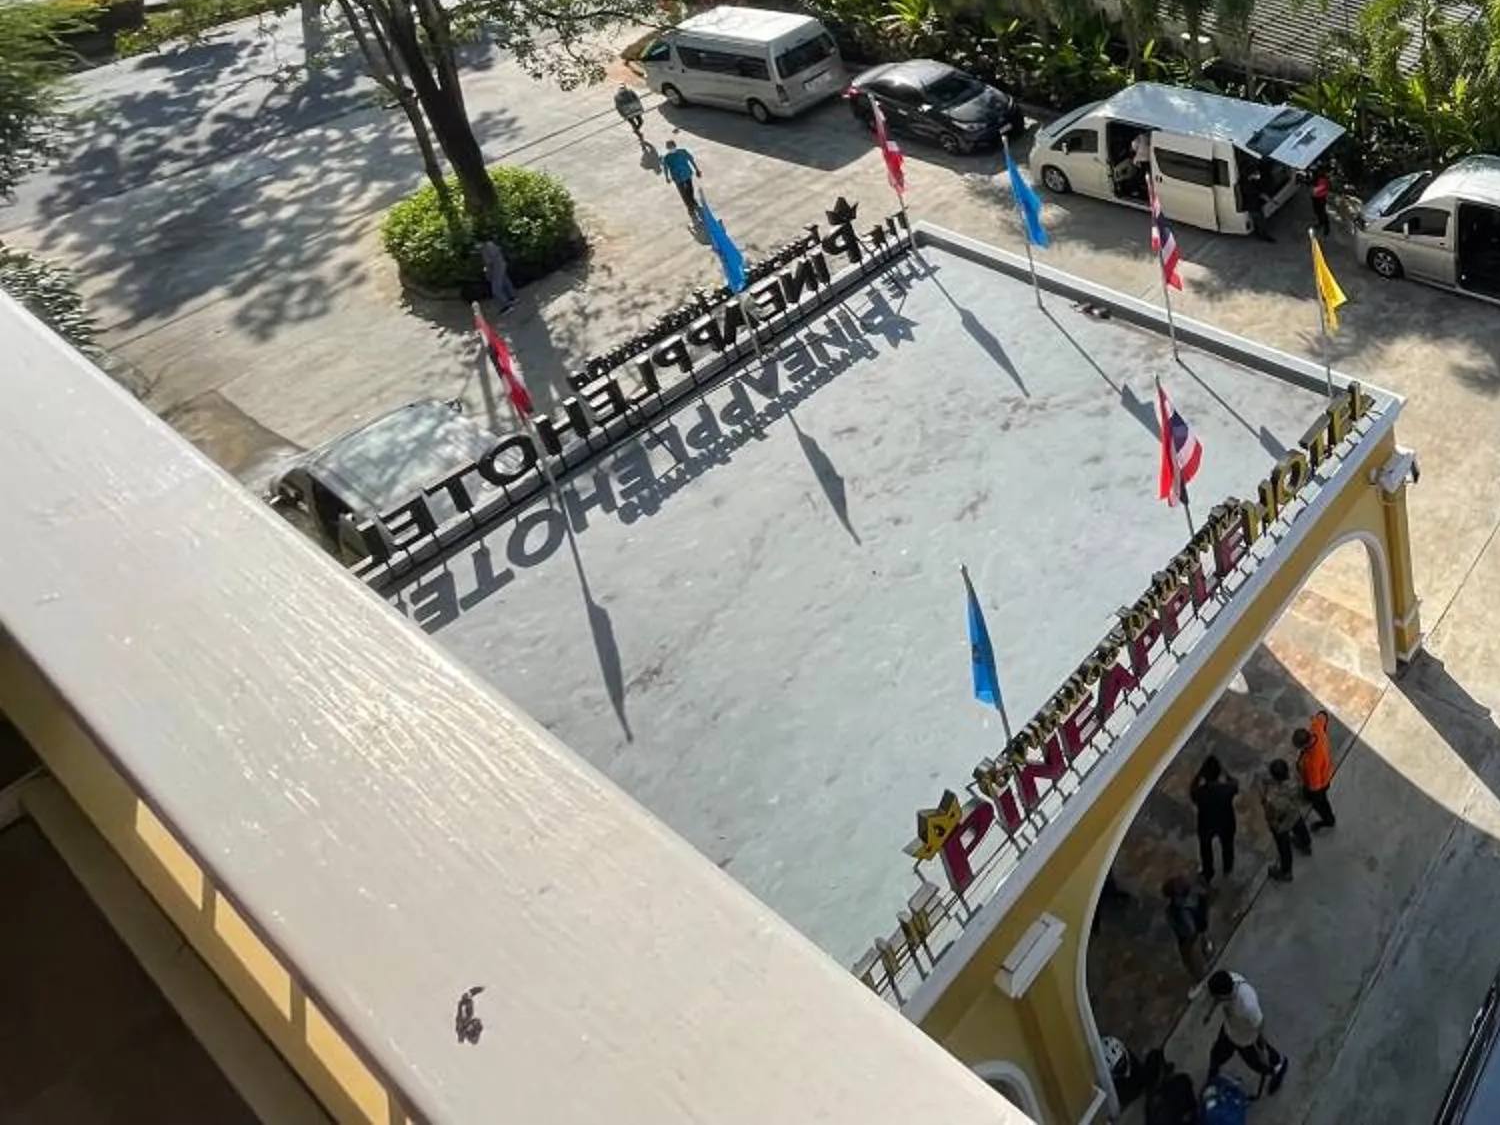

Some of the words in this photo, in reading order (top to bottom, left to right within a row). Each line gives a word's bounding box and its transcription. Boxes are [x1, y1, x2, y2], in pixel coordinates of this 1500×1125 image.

[609, 287, 903, 503] PINEAPPLE
[941, 511, 1251, 893] PINEAPPLE
[1240, 380, 1376, 546] HOTEL
